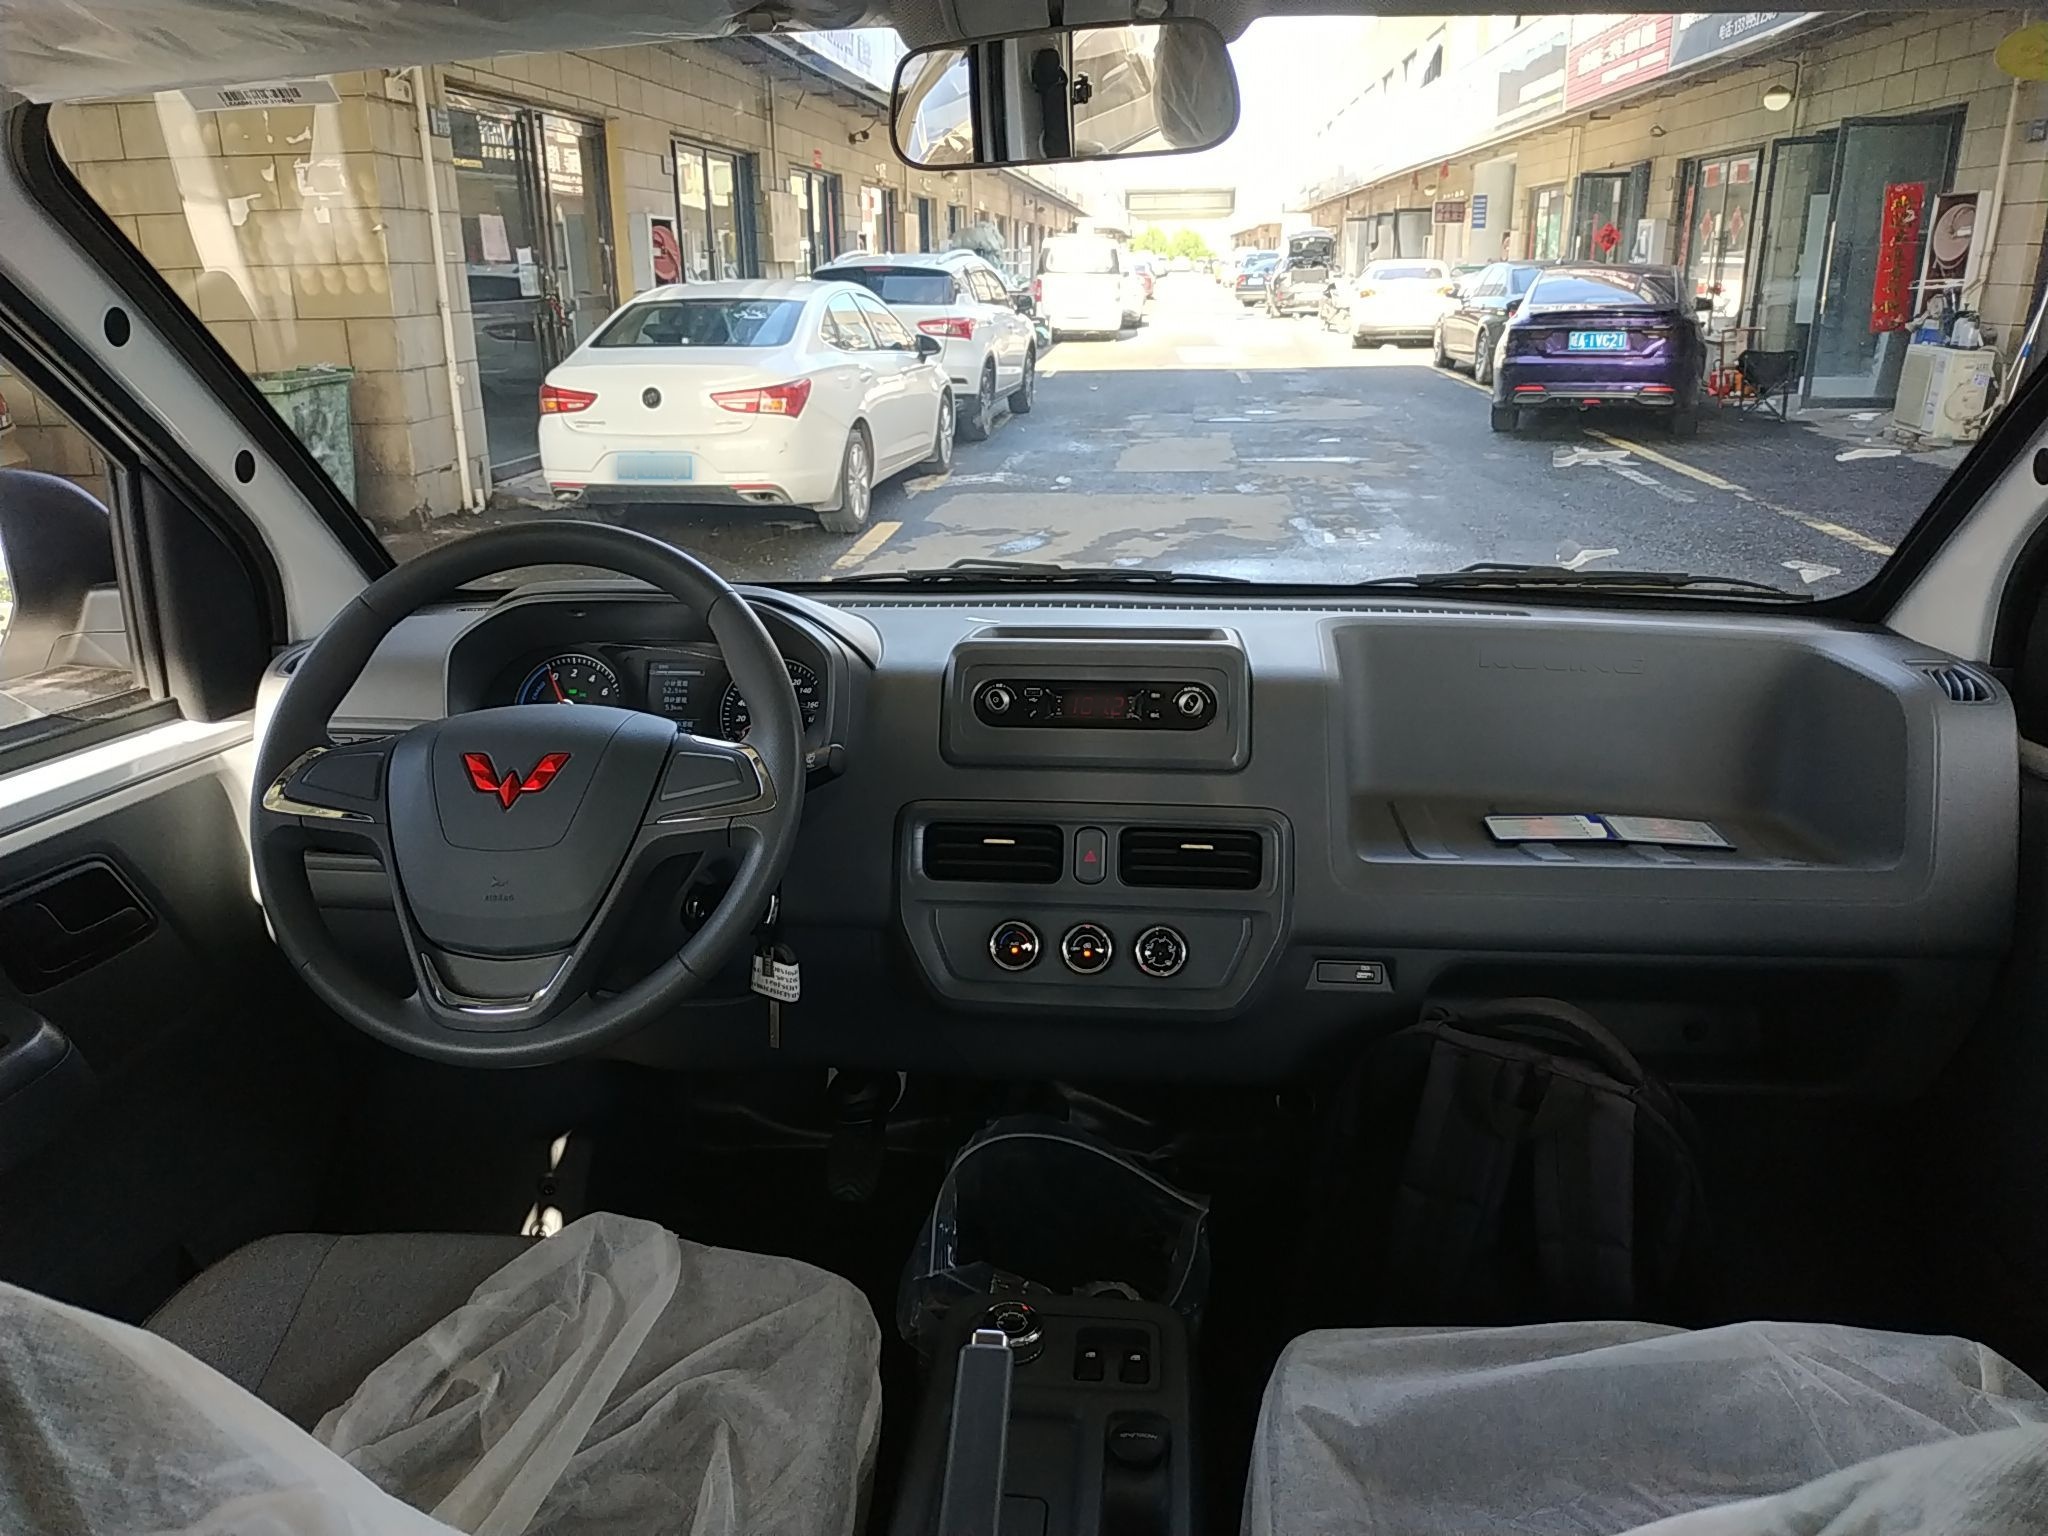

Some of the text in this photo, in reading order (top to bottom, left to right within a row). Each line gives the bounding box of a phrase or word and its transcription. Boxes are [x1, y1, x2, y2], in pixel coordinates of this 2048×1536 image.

[552, 672, 559, 681] 0
[570, 668, 578, 678] 2
[588, 674, 596, 683] 4
[601, 687, 609, 696] 6
[735, 715, 747, 723] 20
